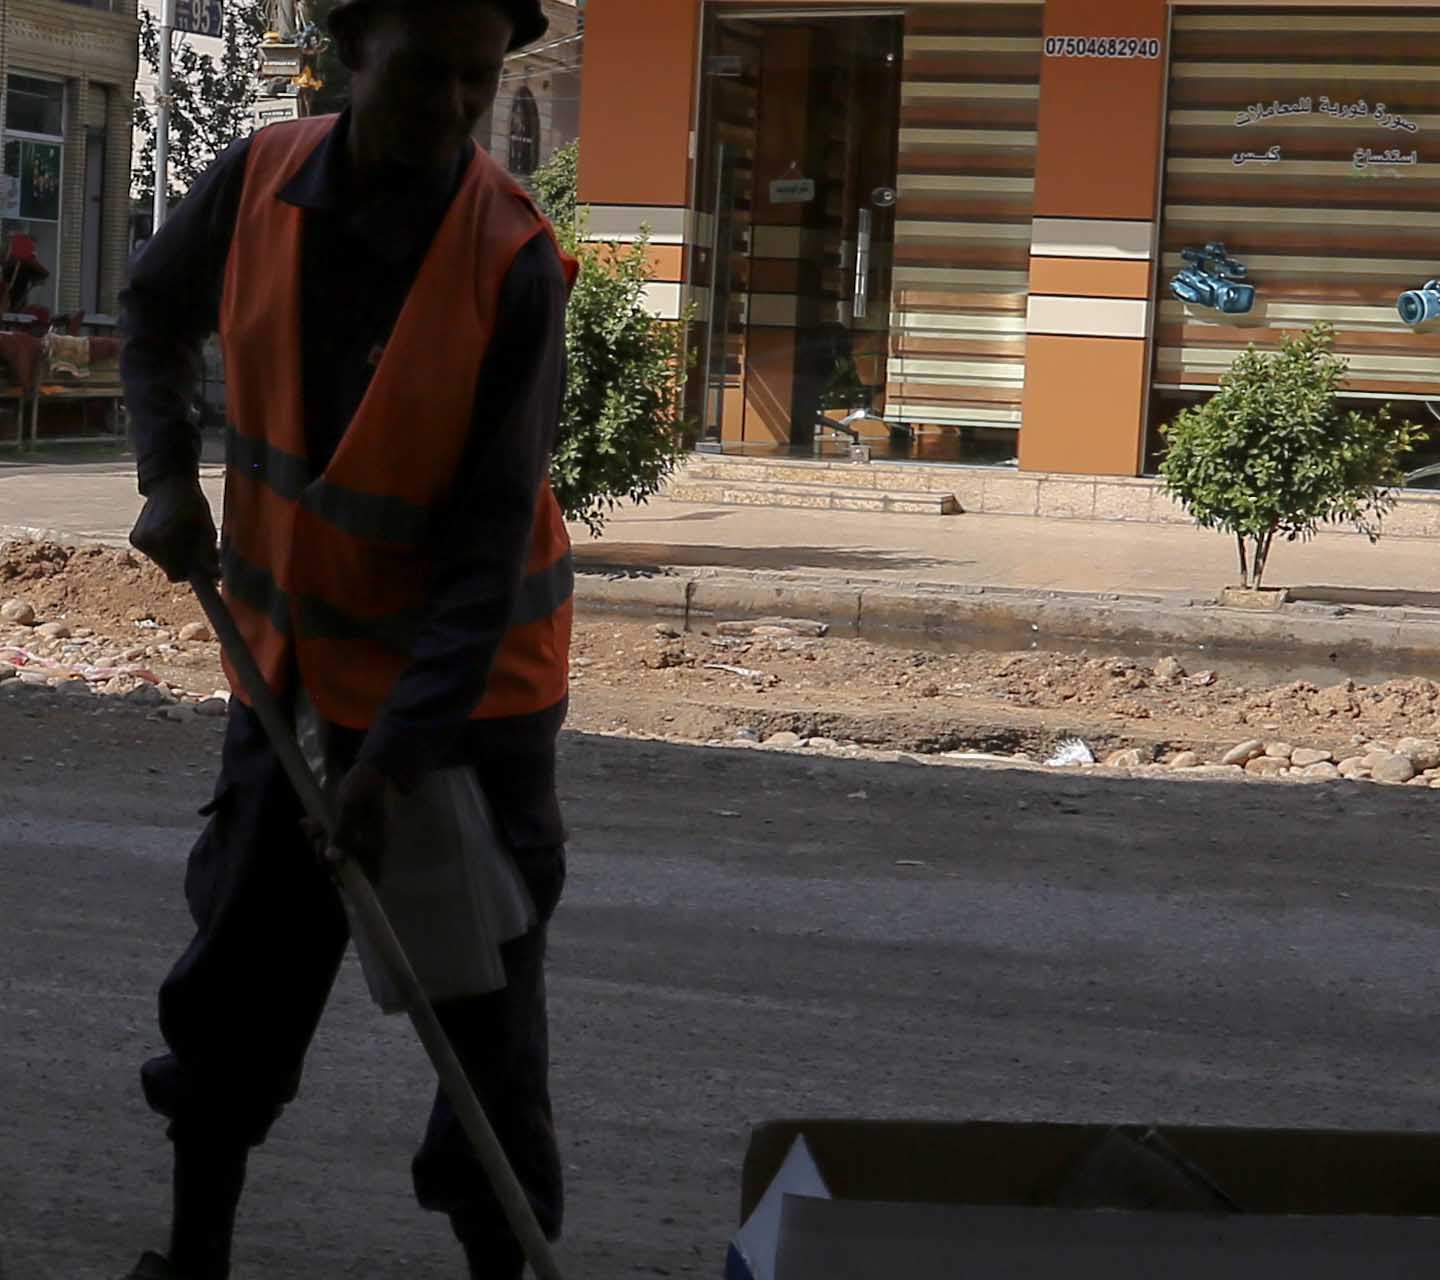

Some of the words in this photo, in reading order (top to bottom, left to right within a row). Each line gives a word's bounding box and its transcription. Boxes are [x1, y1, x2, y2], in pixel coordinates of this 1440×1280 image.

[1044, 37, 1160, 58] 07504682940
[1233, 97, 1313, 127] للمعاملات
[1319, 96, 1369, 119] فورية
[1372, 103, 1418, 132] صورة
[1353, 148, 1418, 170] استنساخ
